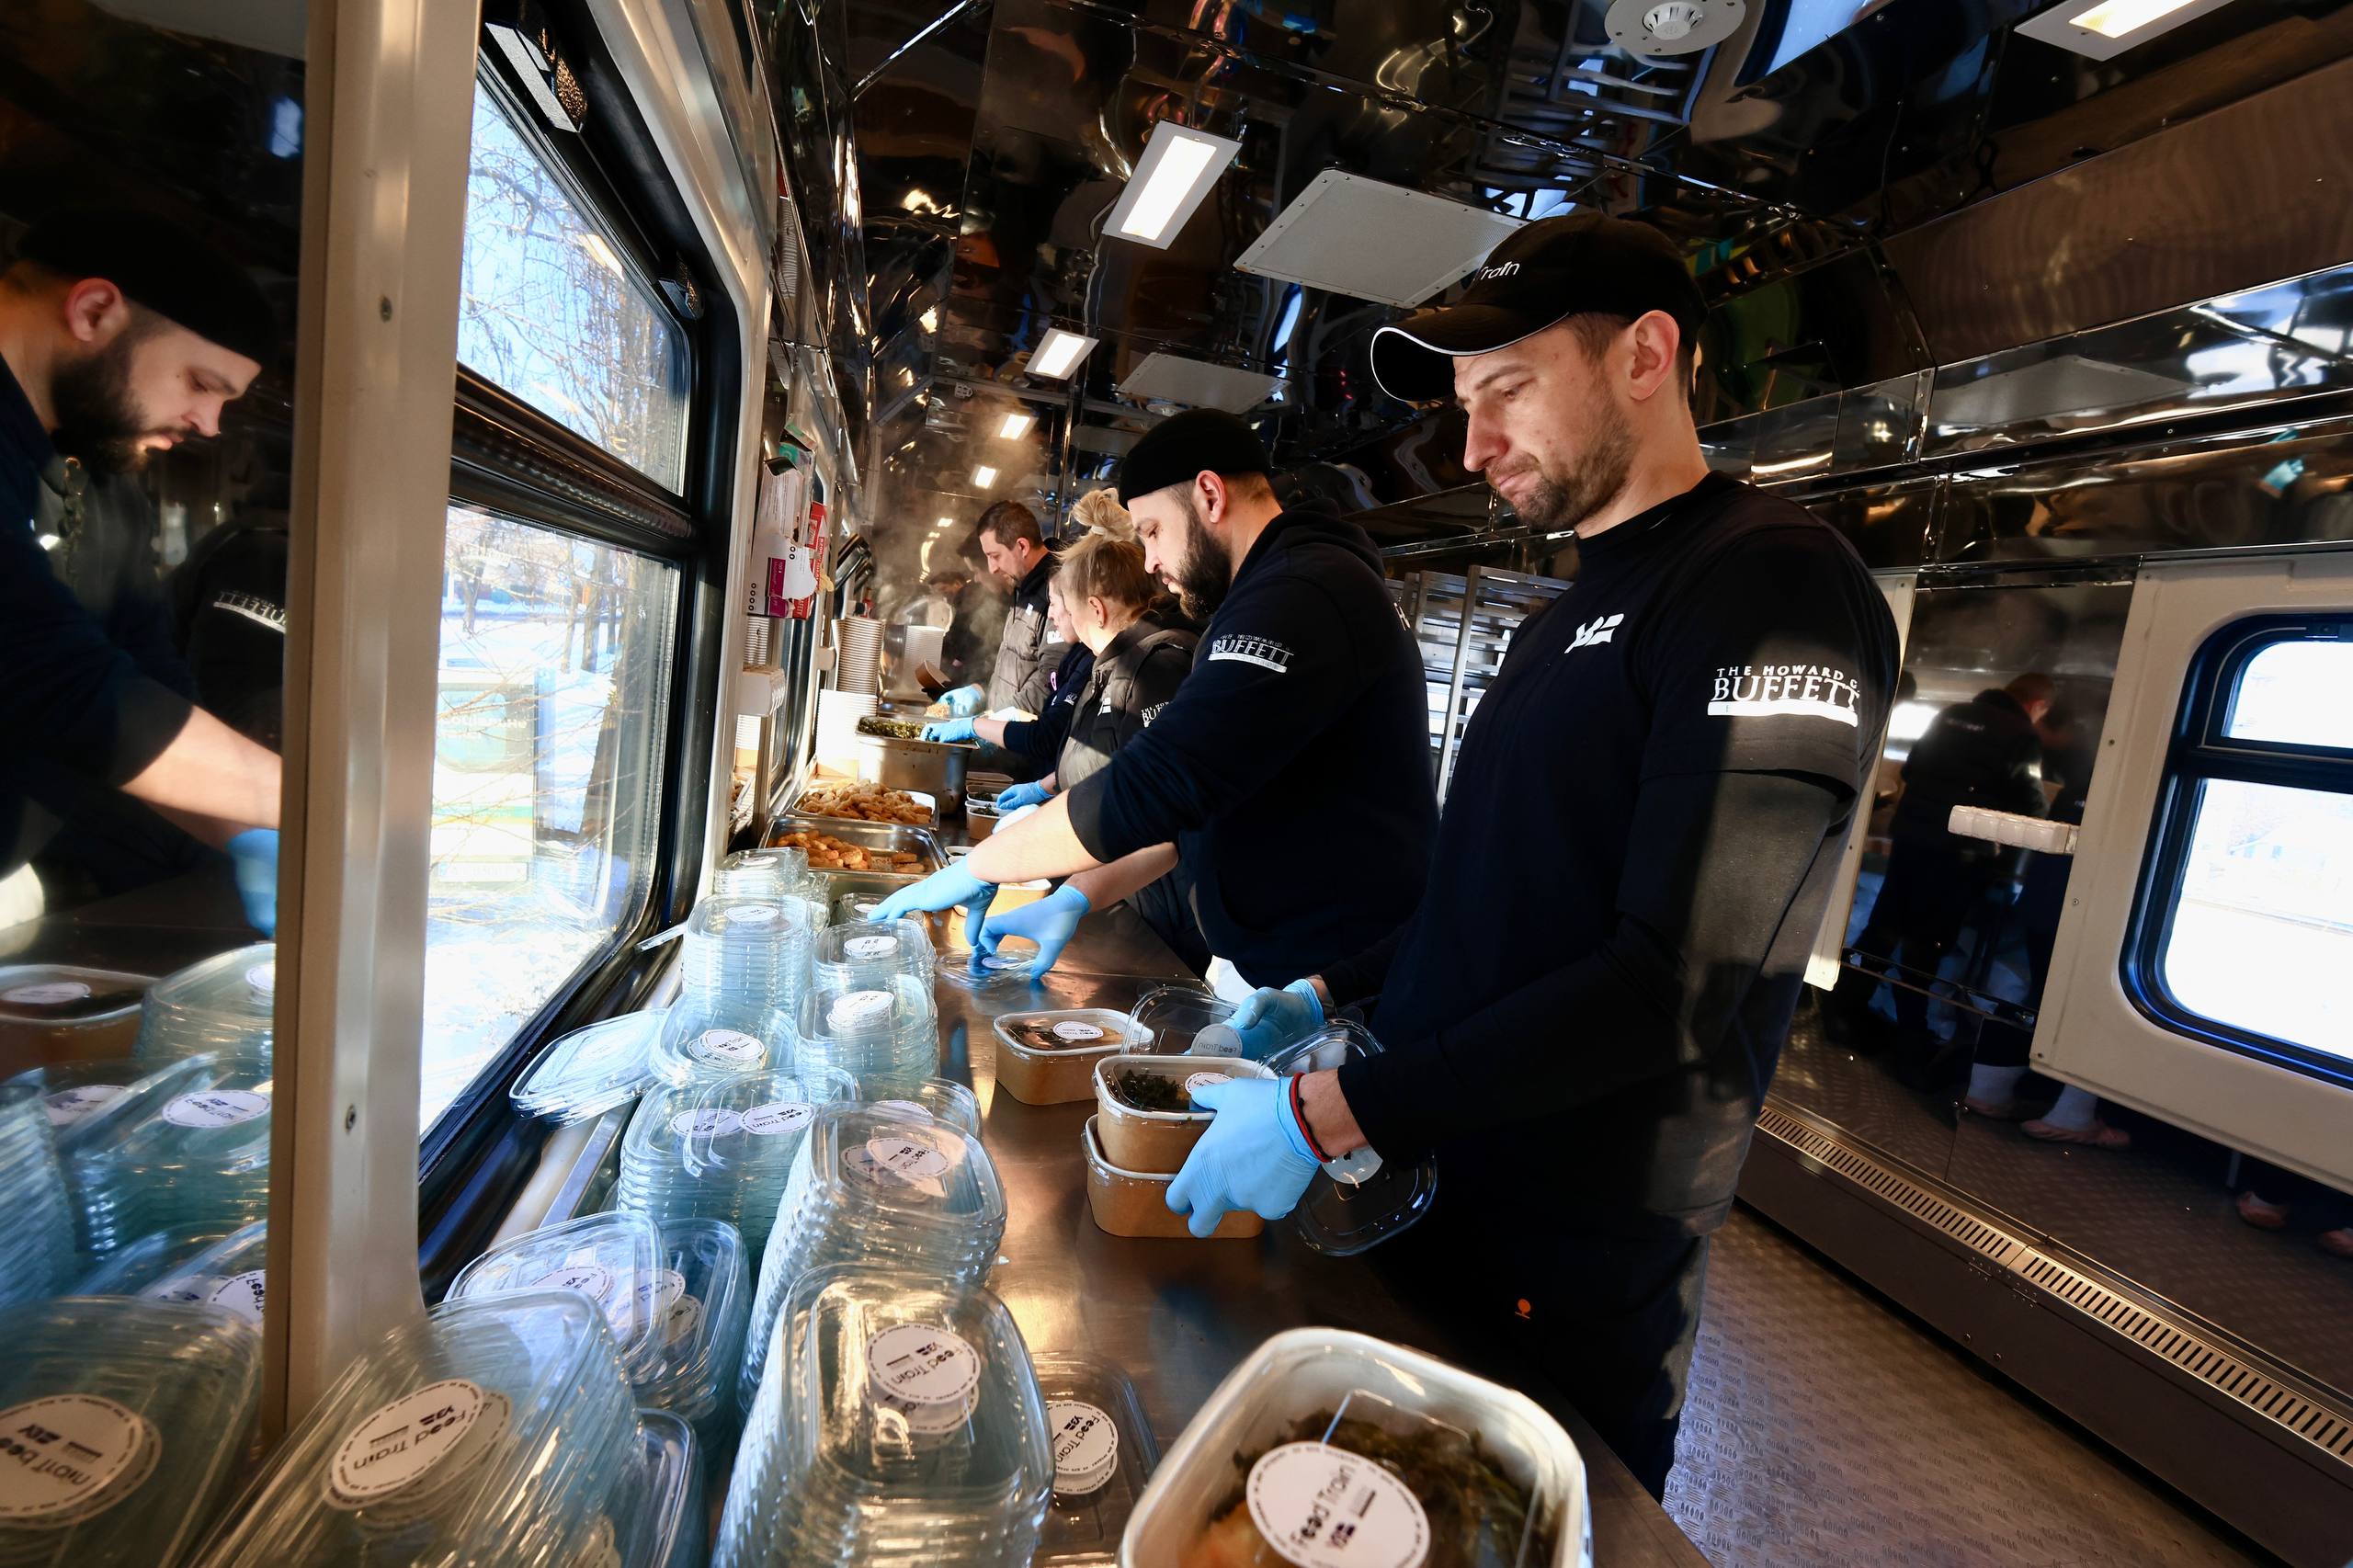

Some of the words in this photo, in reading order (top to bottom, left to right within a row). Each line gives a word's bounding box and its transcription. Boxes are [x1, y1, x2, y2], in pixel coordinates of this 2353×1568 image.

[1211, 639, 1295, 665] BUFFETT
[1716, 665, 1752, 678] THE
[1762, 665, 1844, 681] HOWARD
[1710, 675, 1860, 713] BUFFETT
[891, 1364, 930, 1384] Train
[414, 1410, 466, 1446] Feed
[1075, 1415, 1100, 1441] Feed
[353, 1440, 409, 1470] Train
[1055, 1439, 1081, 1463] Train
